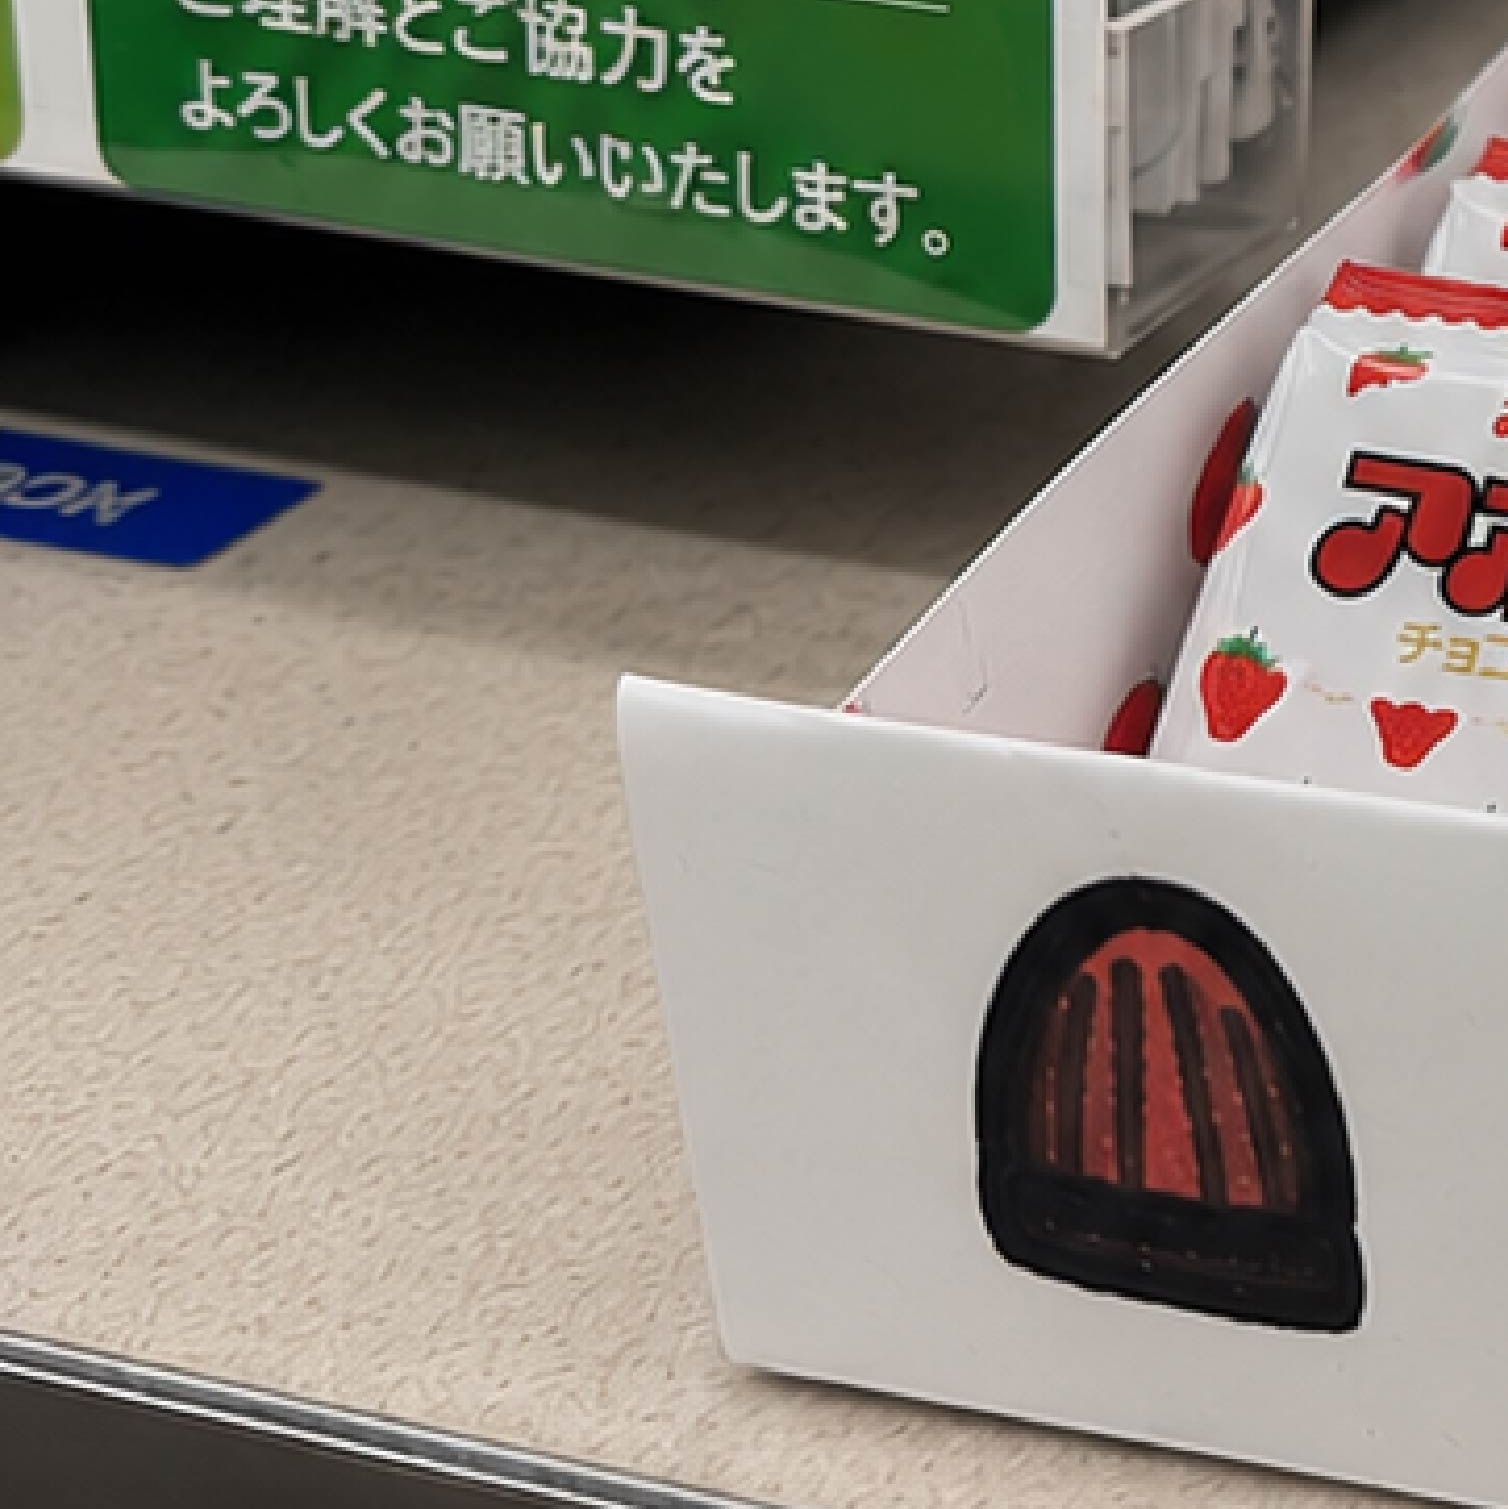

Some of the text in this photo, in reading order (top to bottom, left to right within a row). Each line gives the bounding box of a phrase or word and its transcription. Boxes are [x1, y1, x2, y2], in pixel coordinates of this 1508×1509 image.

[180, 60, 952, 257] よろしくお願いいたします。
